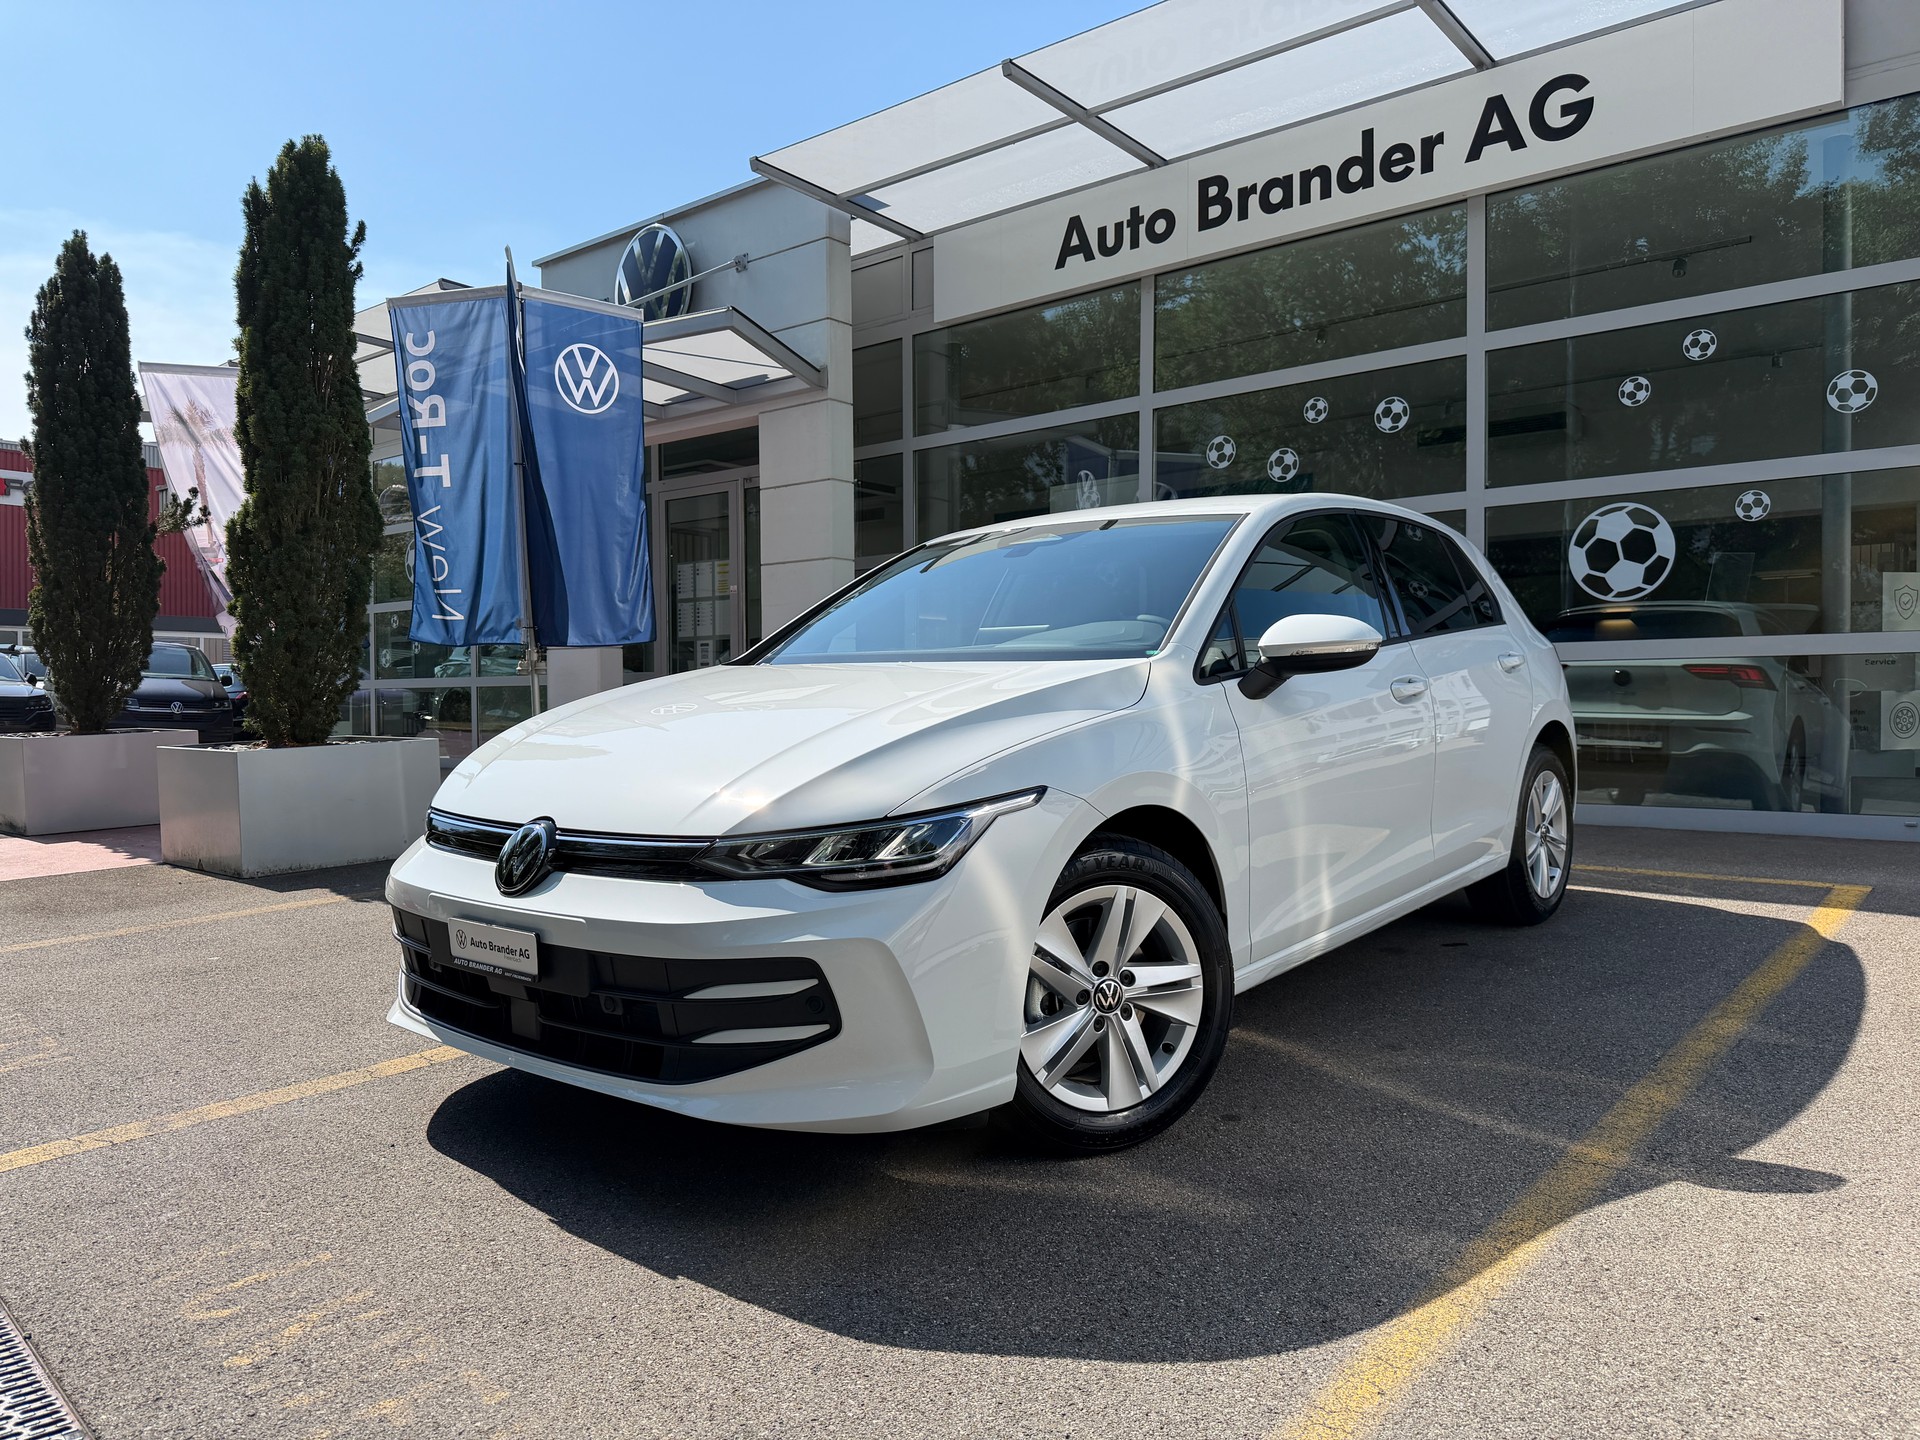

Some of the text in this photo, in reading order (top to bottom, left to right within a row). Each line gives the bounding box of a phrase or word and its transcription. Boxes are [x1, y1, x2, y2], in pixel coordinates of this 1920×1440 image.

[1055, 73, 1595, 270] Auto Brander AG
[1864, 658, 1897, 666] Service
[470, 937, 530, 960] Auto Brander AG
[454, 958, 503, 975] AUTO BRANDER AG
